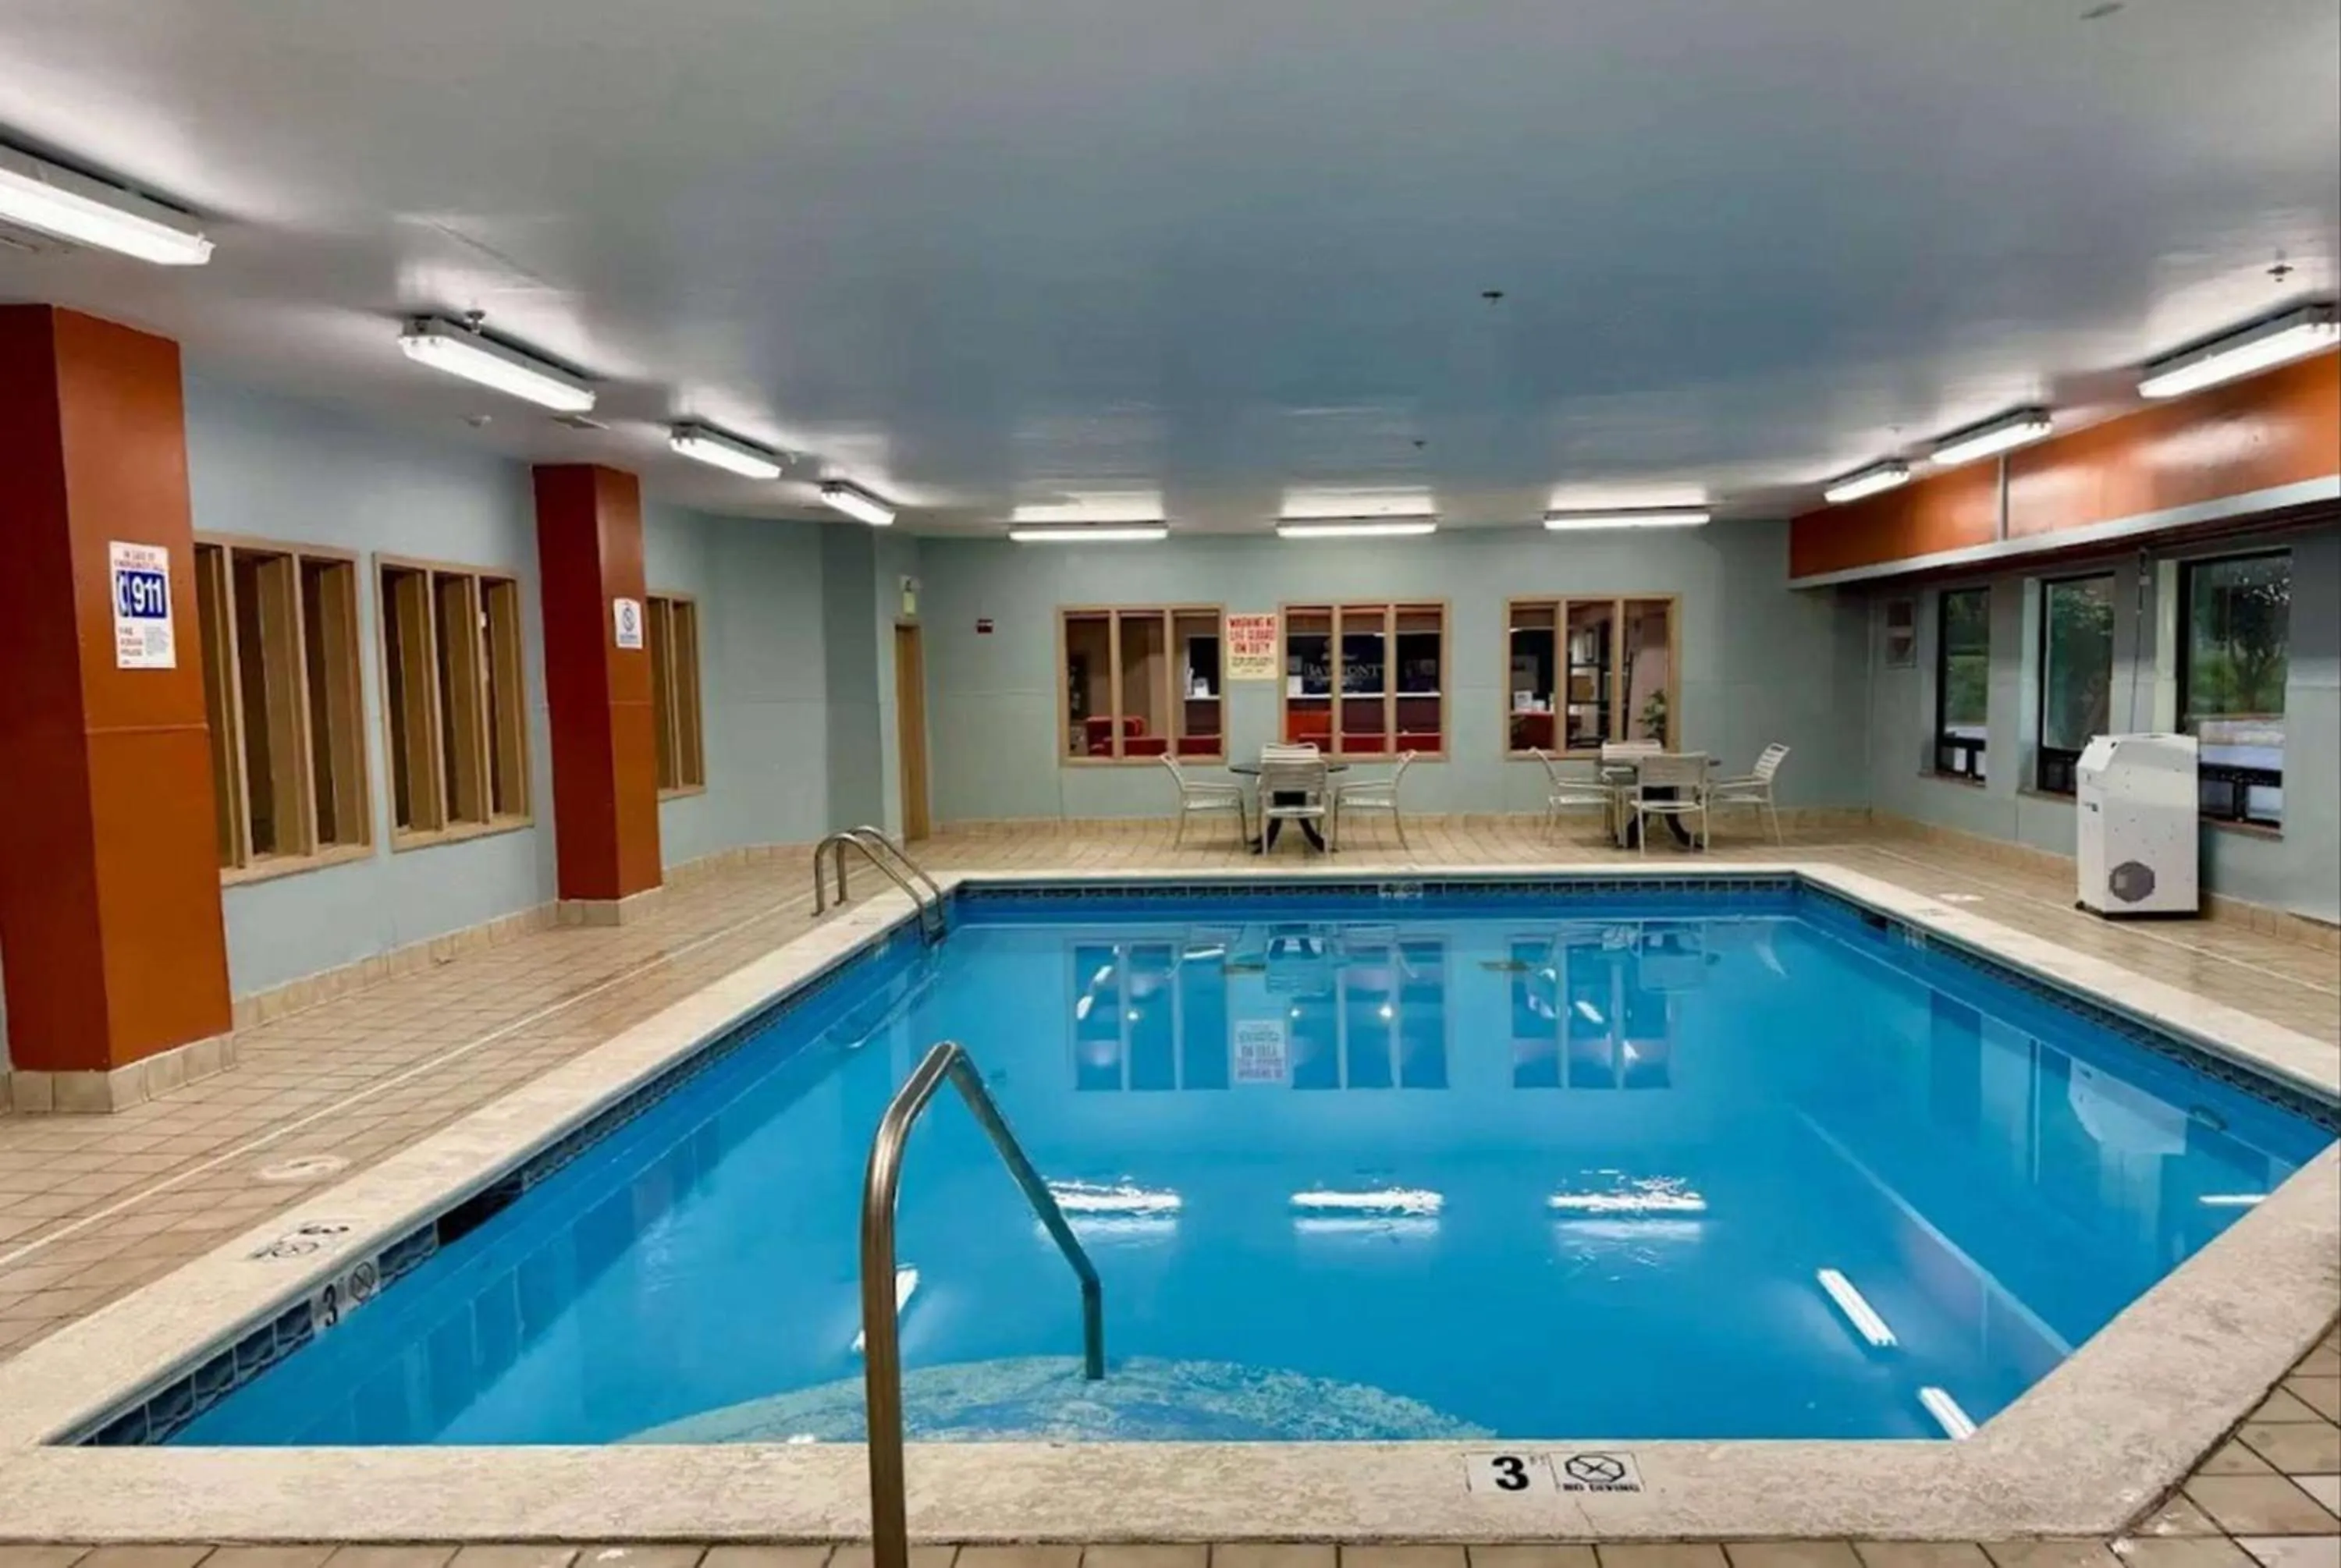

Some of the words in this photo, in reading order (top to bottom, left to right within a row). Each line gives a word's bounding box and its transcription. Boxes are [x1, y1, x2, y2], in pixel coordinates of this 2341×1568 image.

[131, 576, 164, 615] 911
[323, 1283, 338, 1327] 3
[1491, 1455, 1529, 1492] 3
[1562, 1483, 1585, 1492] NO
[1589, 1482, 1641, 1493] DIVING
